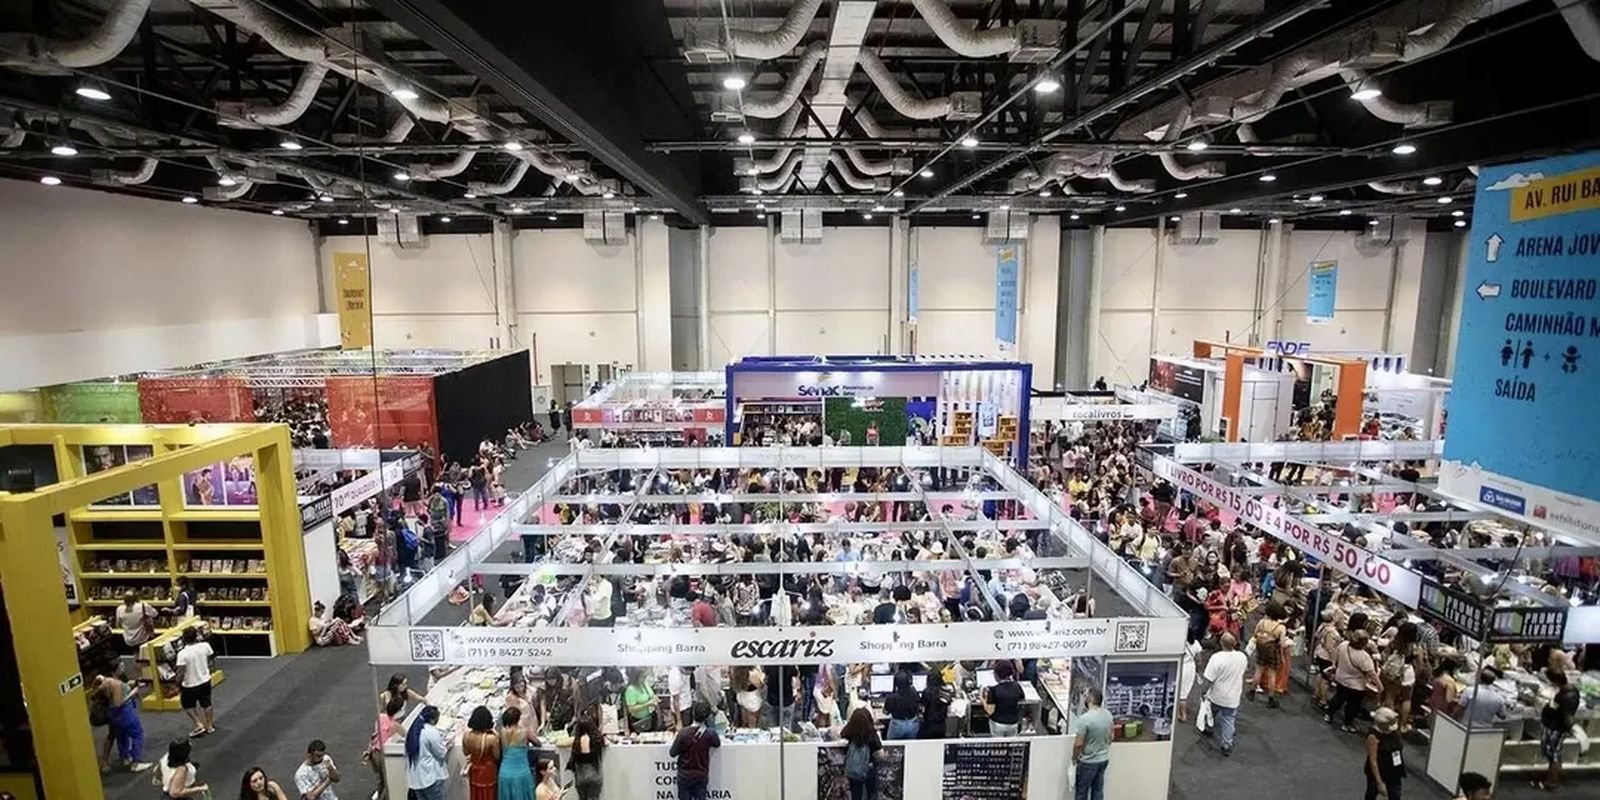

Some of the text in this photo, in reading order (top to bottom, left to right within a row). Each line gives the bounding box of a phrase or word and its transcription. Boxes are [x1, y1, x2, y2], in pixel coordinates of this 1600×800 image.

[1525, 188, 1547, 210] AV.
[1551, 181, 1577, 205] RUI
[1515, 236, 1564, 257] ARENA
[1511, 279, 1596, 300] BOULEVARD
[1505, 311, 1585, 336] CAMINHÃO
[1495, 376, 1536, 402] SAÍDA
[1171, 464, 1194, 485] LIVRO
[1195, 478, 1214, 496] POR
[1216, 487, 1228, 504] R$
[1273, 515, 1281, 529] 4
[1284, 521, 1309, 545] POR
[1313, 534, 1330, 555] R$
[1333, 543, 1391, 584] 50,00
[1445, 607, 1480, 633] LIVROS
[1524, 612, 1563, 624] PROMO
[467, 635, 568, 644] www.escariz.com.br
[1522, 624, 1562, 636] LIVROS
[676, 643, 706, 652] Barra
[731, 631, 834, 658] escariz
[860, 639, 947, 651] Shopng Barra
[656, 790, 674, 800] NA
